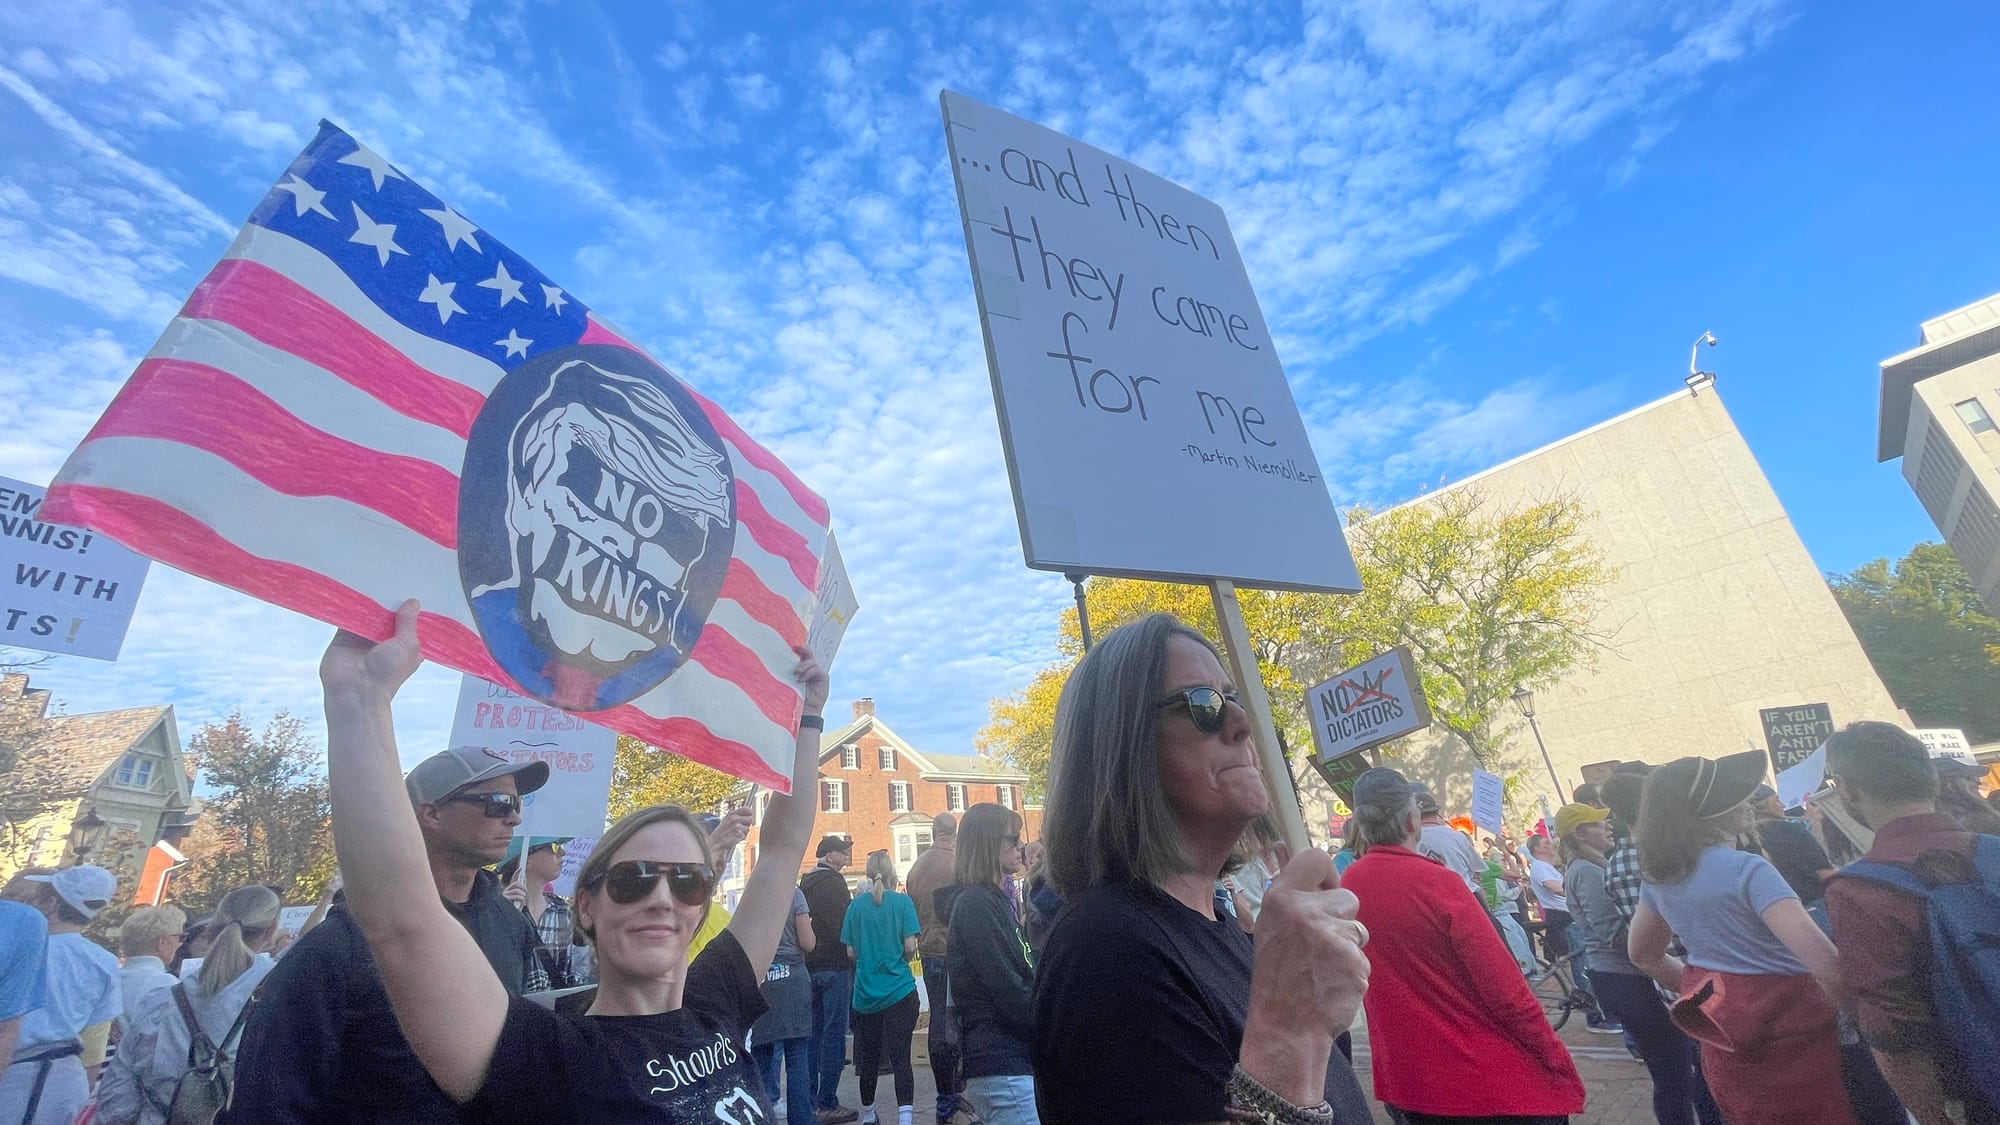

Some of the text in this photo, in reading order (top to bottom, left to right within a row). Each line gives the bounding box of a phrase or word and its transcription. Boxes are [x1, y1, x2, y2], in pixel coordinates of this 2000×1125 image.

[1104, 164, 1220, 260] then
[991, 206, 1259, 351] they came
[1047, 312, 1277, 446] for me
[1244, 455, 1317, 483] Niemöller
[594, 471, 664, 539] NO
[15, 563, 119, 601] WITH
[556, 533, 671, 634] KINGS
[1320, 684, 1350, 721] NO
[1327, 697, 1404, 743] DICTATORS
[1764, 708, 1817, 723] IF YOU
[1770, 720, 1832, 737] AREN'T
[1778, 736, 1820, 749] ANTI
[646, 1032, 737, 1095] Shovels
